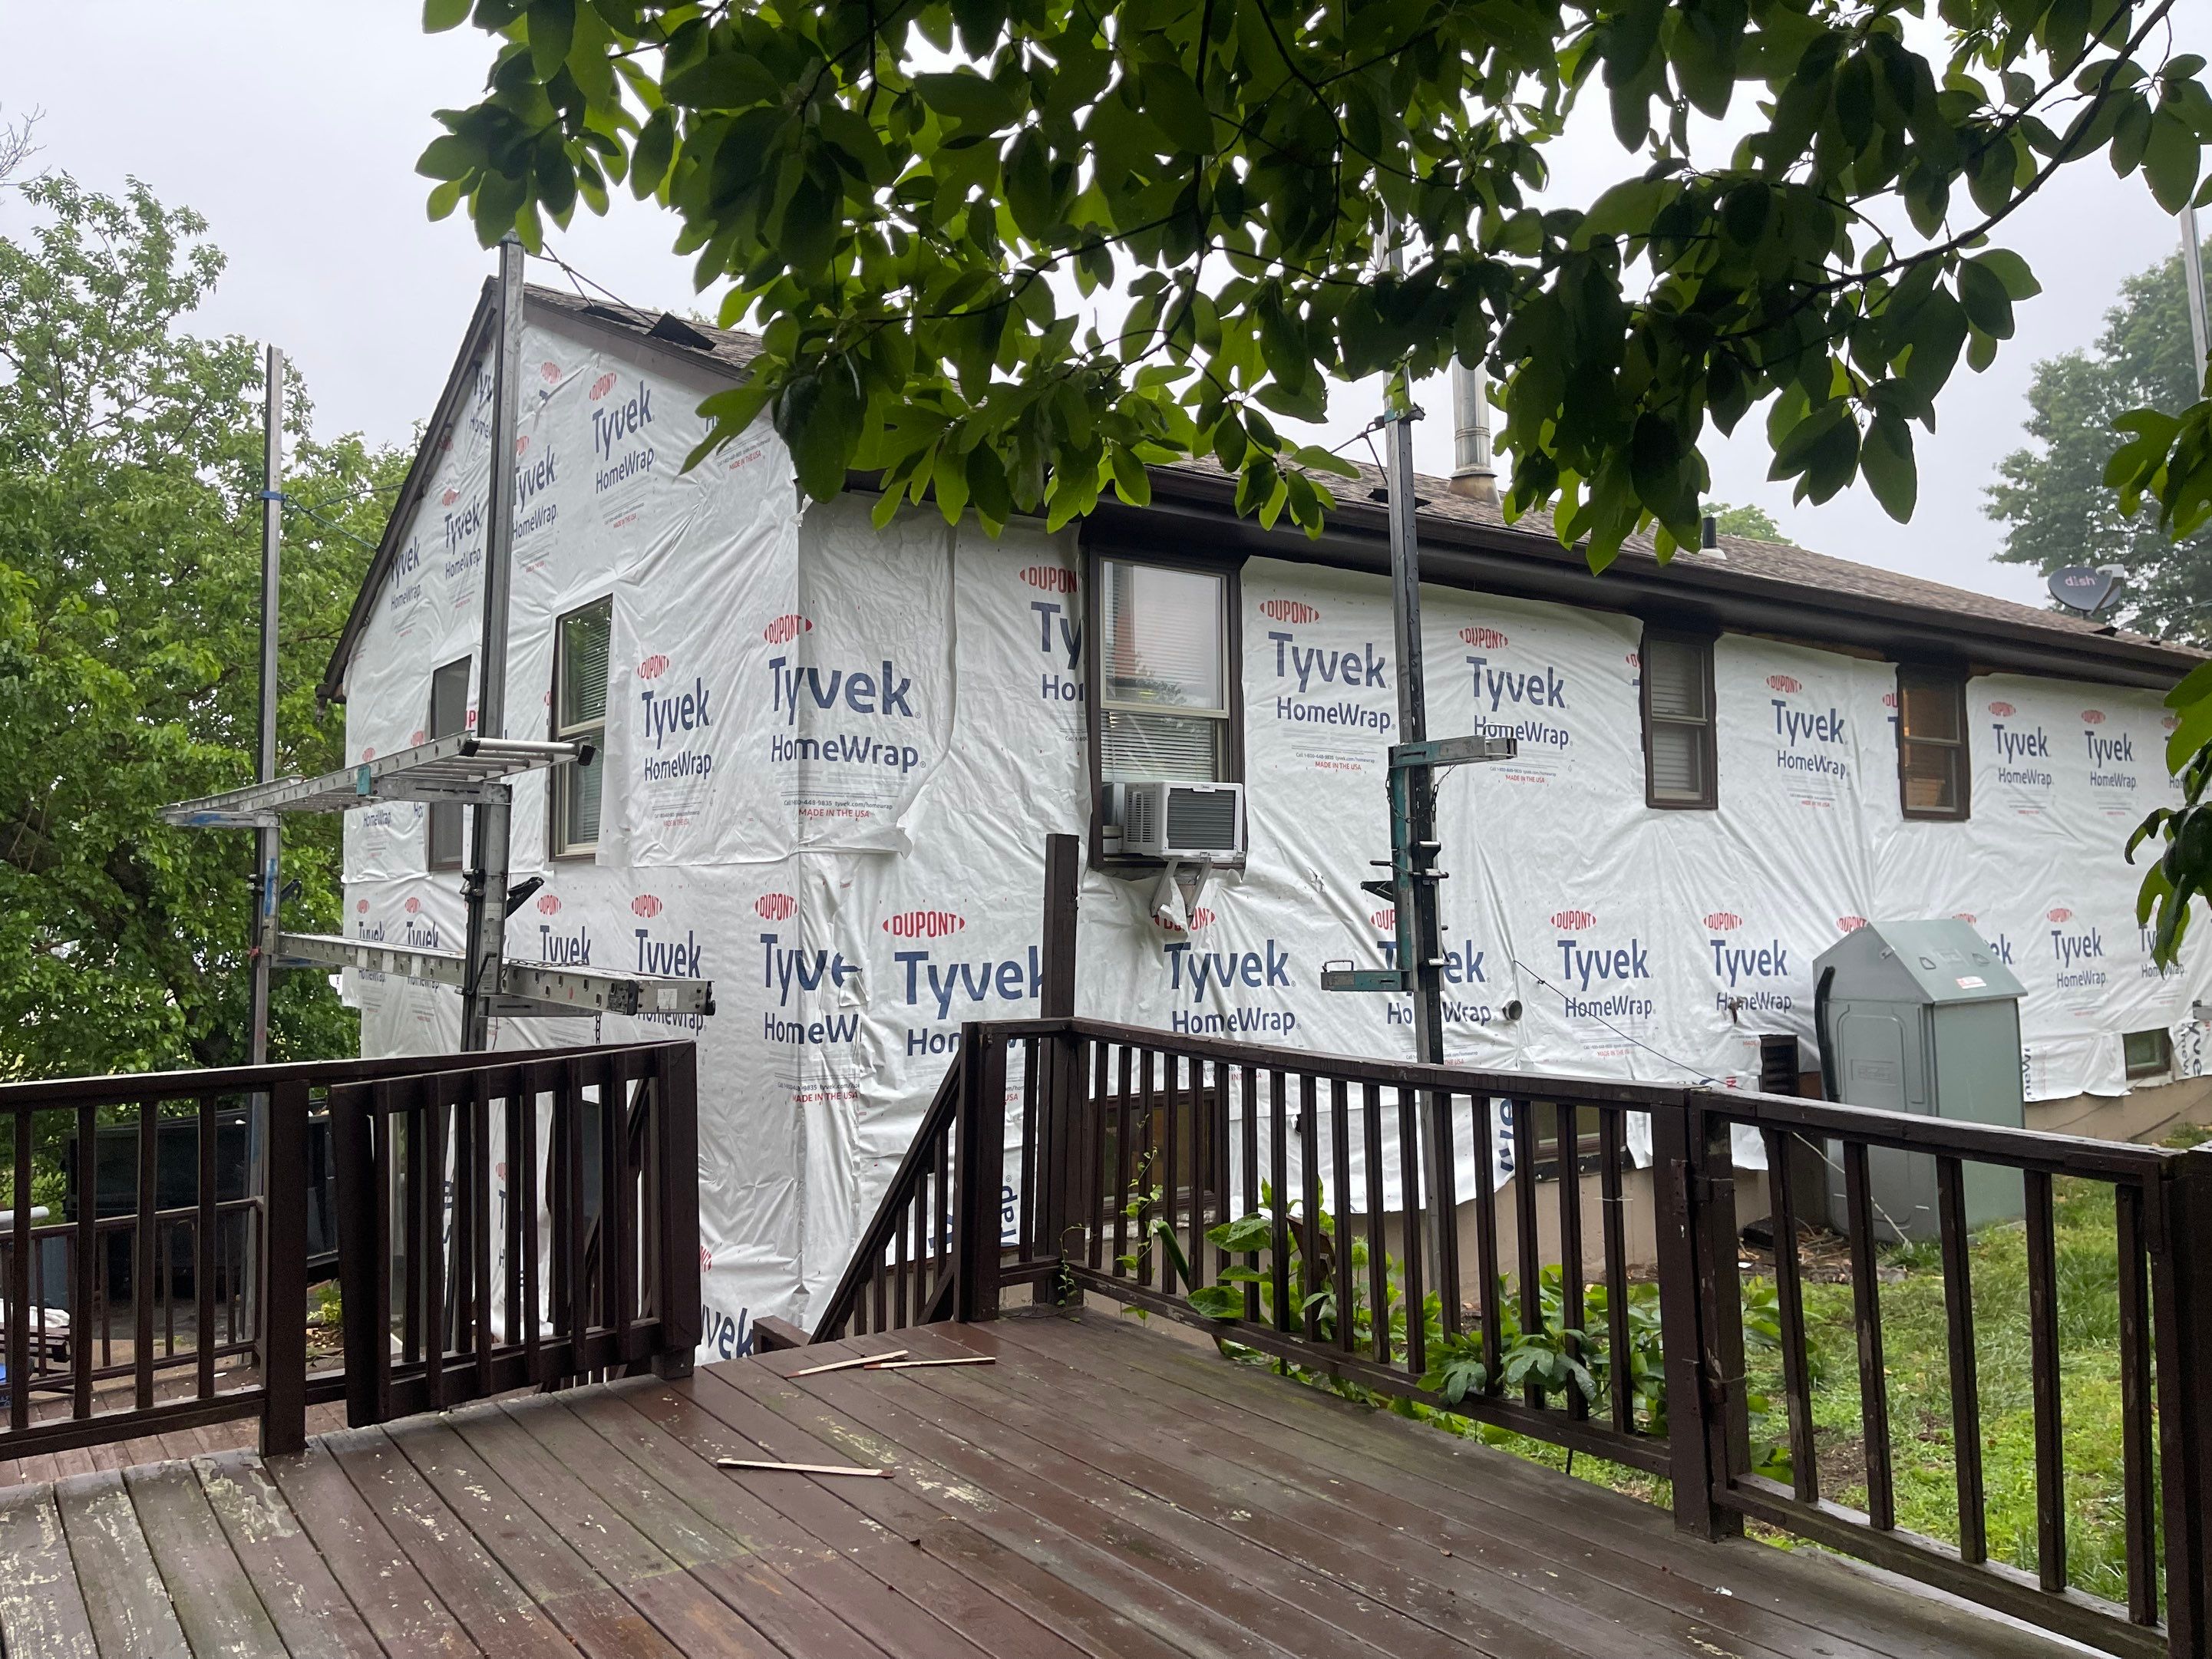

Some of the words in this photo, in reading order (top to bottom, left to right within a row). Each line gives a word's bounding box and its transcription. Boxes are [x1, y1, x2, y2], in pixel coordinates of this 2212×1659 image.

[593, 380, 652, 461] Tyvek
[516, 444, 556, 513] yvek
[596, 447, 655, 494] HomeWrap
[444, 495, 480, 555] Tyvek
[445, 547, 481, 580] HomeWrap
[1028, 566, 1078, 593] DUPON
[2065, 576, 2095, 586] dish
[391, 583, 421, 611] HomeWrap
[1267, 600, 1313, 624] DUPONT
[769, 614, 802, 644] DUPONT
[1465, 628, 1503, 649] DUPONT
[641, 655, 666, 680] DUPONT
[1268, 631, 1386, 693] Tyvek
[769, 656, 913, 725] Tyvek
[1467, 656, 1566, 712] Tyvek
[1771, 674, 1799, 694] DUPONT
[642, 677, 709, 750] Tyvek
[1277, 696, 1391, 734] HomeWrap
[1771, 699, 1844, 747] Tyvek
[771, 734, 918, 773] HomeWrap
[1992, 724, 2049, 764] Tyvek
[2085, 731, 2133, 768] Tyvek
[644, 750, 712, 781] HomeWrap
[1777, 750, 1845, 780] HomeWrap
[1999, 767, 2052, 789] HomeWrap
[2090, 771, 2136, 791] HomeWrap
[799, 809, 824, 817] MADE
[837, 809, 853, 817] THE
[855, 810, 870, 818] USA
[634, 895, 659, 918] DUPONT
[760, 893, 794, 921] DUPONT
[1375, 909, 1396, 930] DUP
[1557, 910, 1592, 930] DUPONT
[1708, 912, 1738, 931] DUPONT
[893, 911, 956, 938] DUPONT
[636, 929, 701, 978] Tyvek
[2051, 927, 2103, 968] Tyvek
[761, 933, 863, 1007] Tyve
[1164, 939, 1290, 1002] Tyvek
[1557, 938, 1650, 991] Tyvek
[1710, 939, 1788, 988] Tyvek
[2057, 970, 2106, 988] HomeWrap
[1172, 1007, 1296, 1036] HomeWrap
[1388, 1002, 1491, 1027] HoWrap
[1565, 996, 1652, 1019] HomeWrap
[764, 1011, 861, 1044] HomeW
[815, 1093, 824, 1101] IN
[826, 1092, 841, 1100] THE
[844, 1091, 858, 1100] USA
[702, 1304, 754, 1360] vek
